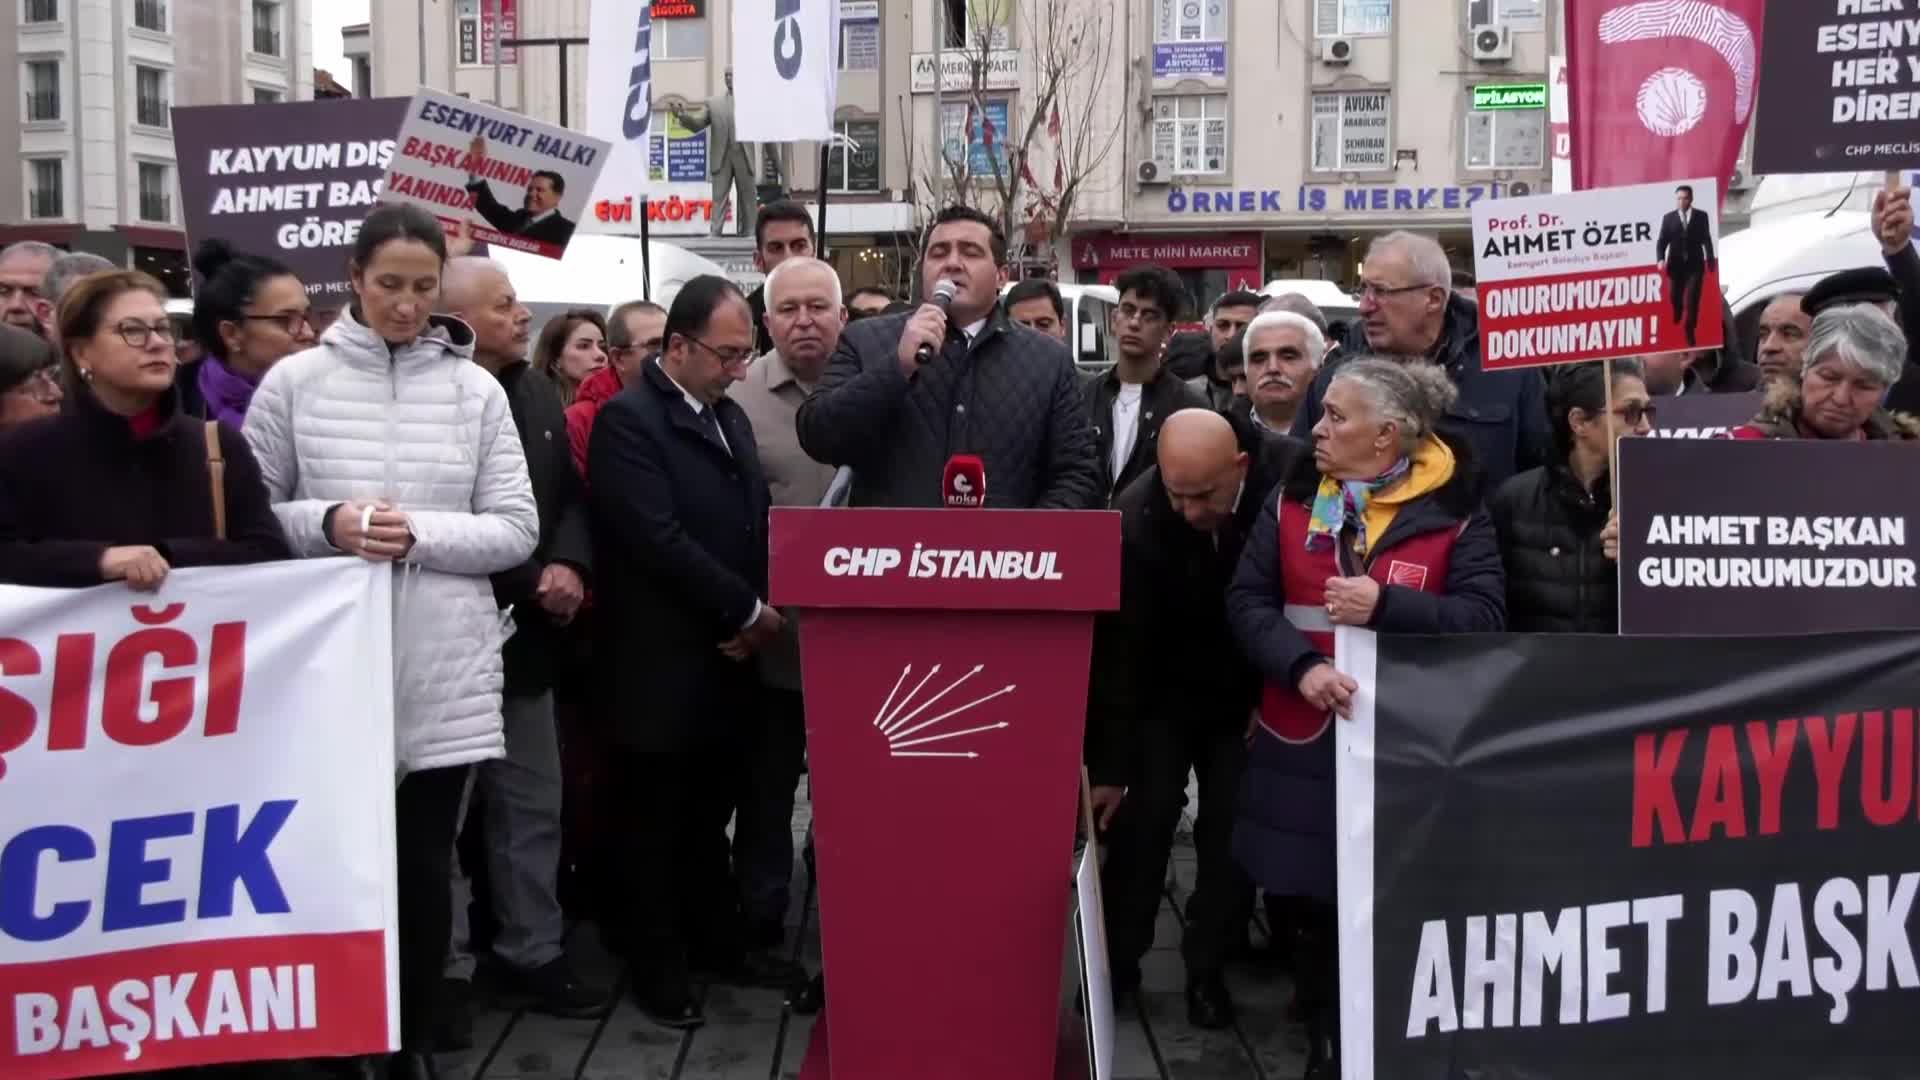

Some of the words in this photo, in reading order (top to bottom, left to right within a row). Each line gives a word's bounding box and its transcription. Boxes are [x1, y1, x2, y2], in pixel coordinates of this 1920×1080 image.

[1837, 0, 1904, 16] HER
[1831, 57, 1900, 88] HER
[1344, 95, 1386, 112] AVUKAT
[1475, 90, 1544, 105] EPİLASYON
[419, 102, 533, 148] ESENYURT
[532, 132, 597, 167] HALKI
[1844, 145, 1871, 156] CHP
[208, 143, 341, 176] KAYYUM
[401, 136, 535, 188] BAŞKANININ
[210, 183, 324, 215] AHMET
[388, 172, 479, 212] YANINDA
[1167, 184, 1282, 213] ÖRNEK
[1482, 229, 1577, 258] AHMET
[1582, 220, 1652, 247] ÖZER
[1488, 215, 1532, 232] Prof.
[1538, 213, 1564, 227] Dr.
[1109, 246, 1151, 260] METE
[1153, 244, 1187, 259] MİNİ
[1189, 245, 1251, 258] MARKET
[1485, 273, 1663, 319] ONURUMUZDUR
[1487, 317, 1643, 361] DOKUNMAYIN
[1649, 315, 1659, 345] !
[1646, 515, 1761, 546] AHMET
[1767, 516, 1906, 551] BAŞKAN
[823, 547, 901, 577] CHP
[908, 542, 1064, 580] İSTANBUL
[1637, 556, 1918, 588] GURURUMUZDUR
[1405, 893, 1685, 1040] AHMET
[14, 964, 318, 1061] BAŞKANI
